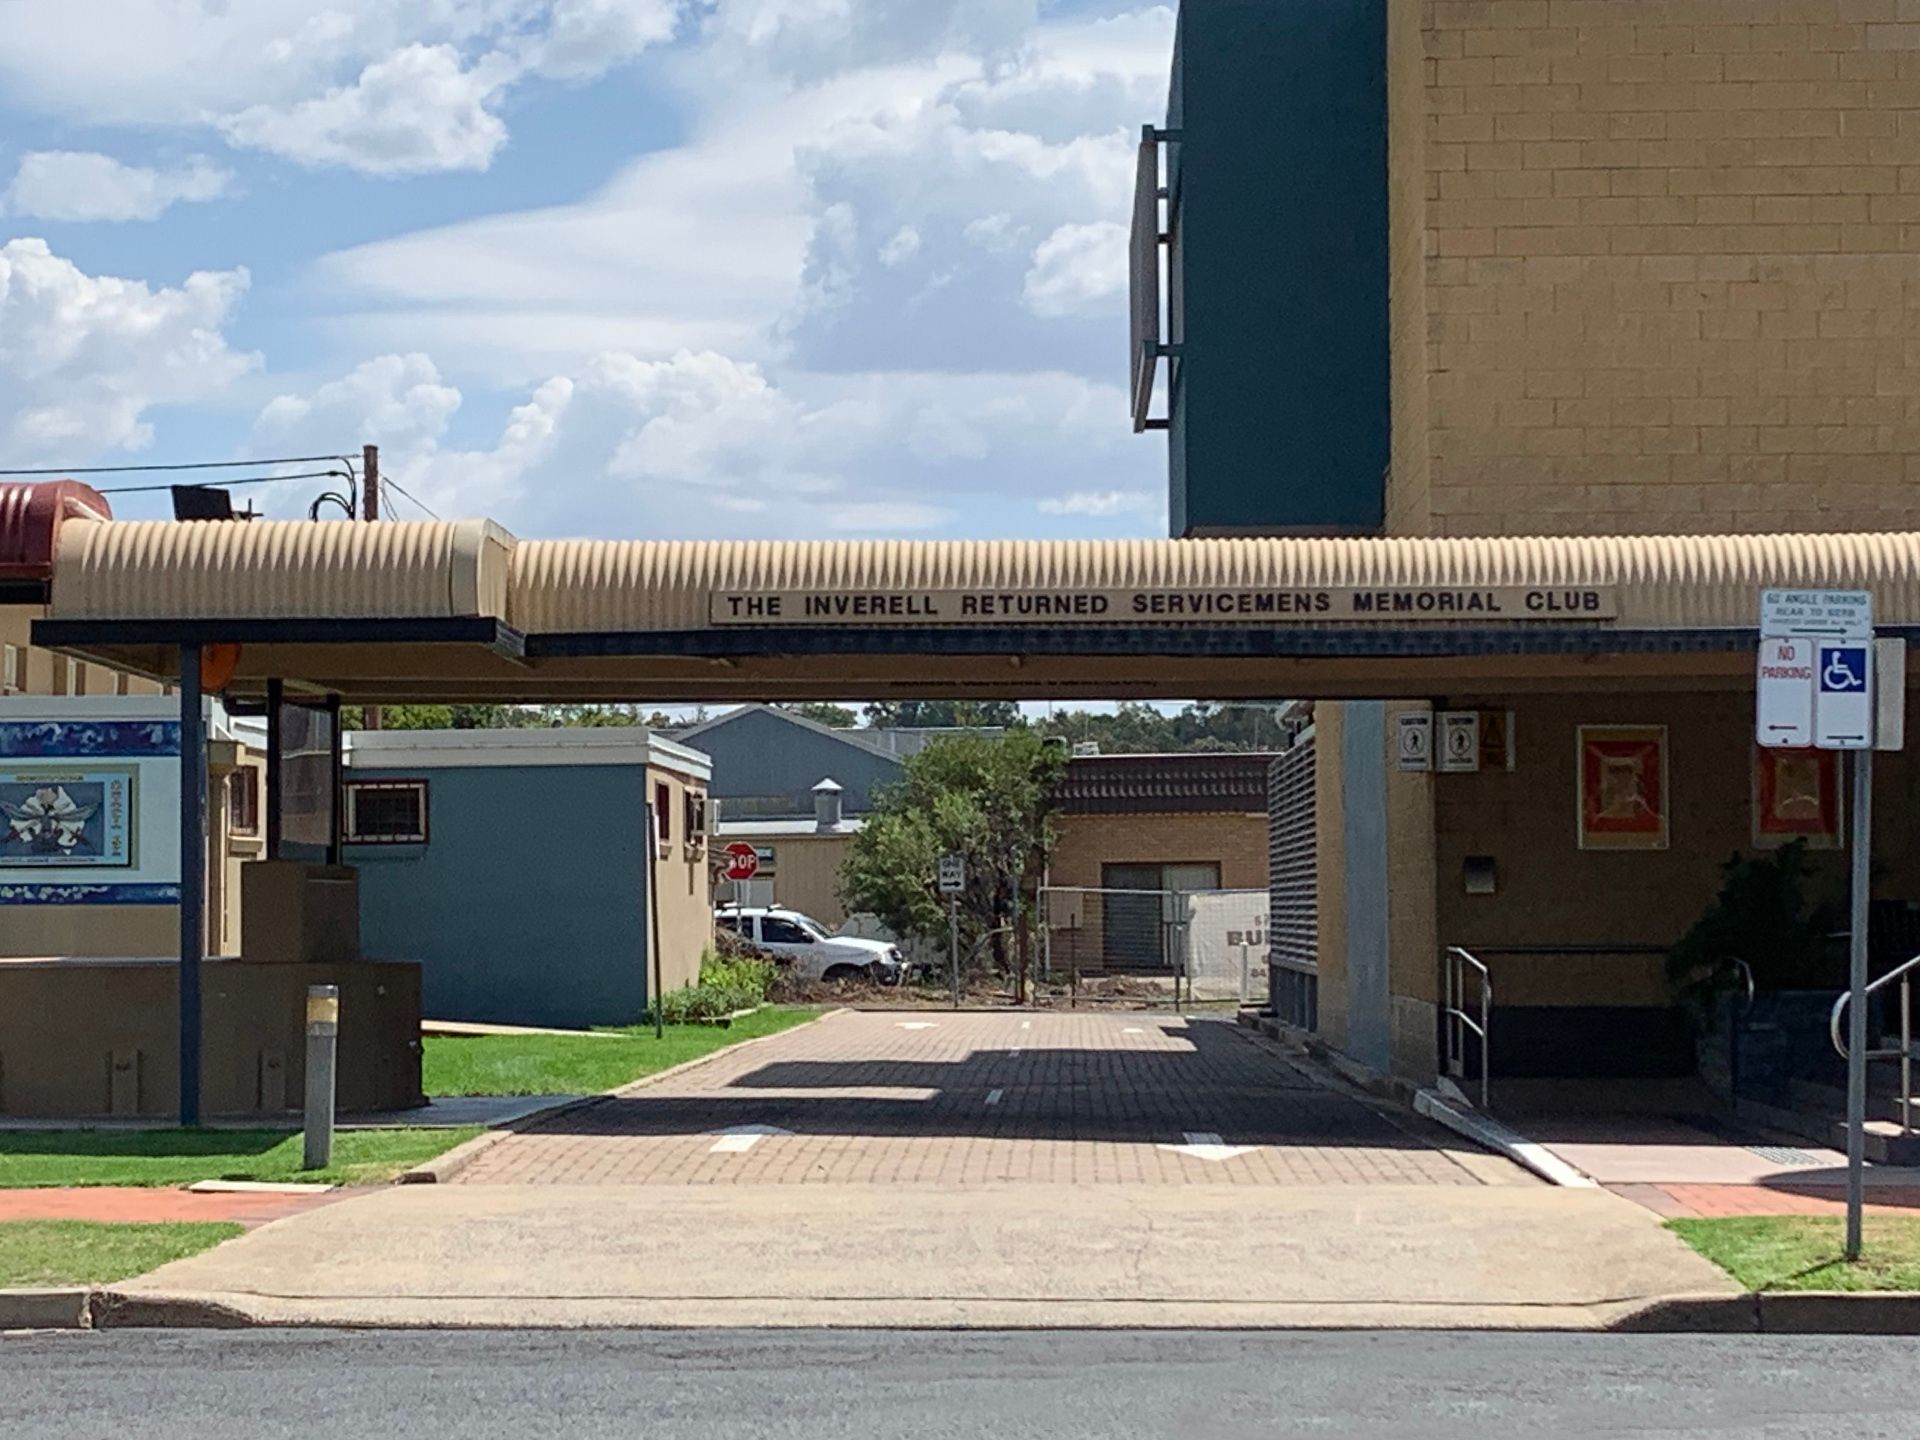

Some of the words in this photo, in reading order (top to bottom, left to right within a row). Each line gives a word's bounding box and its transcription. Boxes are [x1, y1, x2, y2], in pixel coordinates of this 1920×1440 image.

[728, 597, 780, 616] THE
[805, 596, 938, 616] INVERELL
[962, 594, 1108, 615] RETURNED
[1133, 593, 1330, 613] SERVICEMENS
[1353, 593, 1500, 612] MEMORIAL
[1525, 592, 1600, 611] CLUB
[1785, 594, 1818, 605] ANGLE
[1823, 594, 1867, 606] PARKING
[1811, 608, 1823, 616] TO
[1777, 645, 1796, 661] NO
[1761, 666, 1812, 680] PARKING
